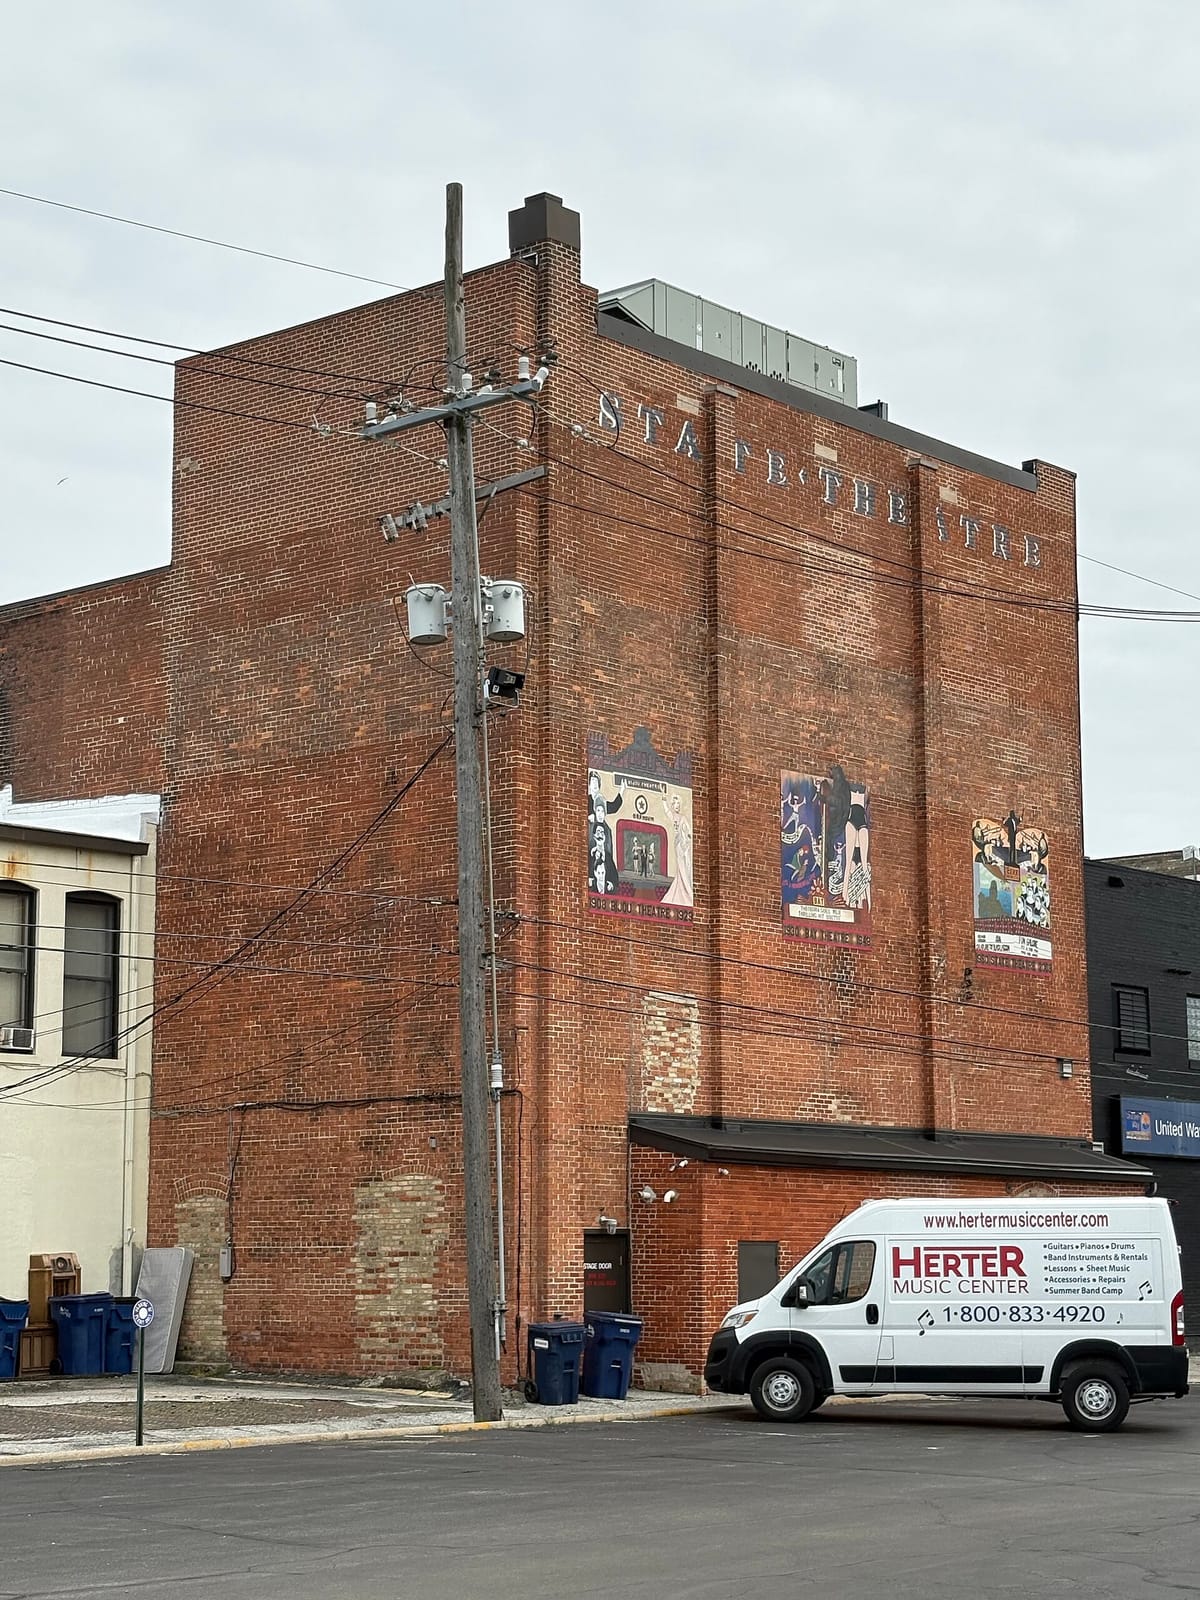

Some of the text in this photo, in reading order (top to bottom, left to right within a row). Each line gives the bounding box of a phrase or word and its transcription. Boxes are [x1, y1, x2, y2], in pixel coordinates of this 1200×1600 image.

[610, 900, 632, 913] BIJOU
[637, 903, 671, 919] THEATRE
[1155, 1119, 1183, 1137] United
[1185, 1122, 1200, 1138] Wa
[923, 1211, 1109, 1228] www.hertermusiccenter.com
[1047, 1242, 1136, 1250] Guitars Pianos Drums
[892, 1245, 1027, 1278] HERTER
[1048, 1253, 1148, 1261] Band Instruments & Rentals
[598, 1262, 612, 1270] DOOR
[1086, 1264, 1108, 1272] Sheet
[1109, 1264, 1131, 1272] Music
[1049, 1275, 1126, 1284] Accessories Repairs
[894, 1279, 1030, 1294] MUSIC CENTER
[1049, 1286, 1124, 1296] Summer Band Camp
